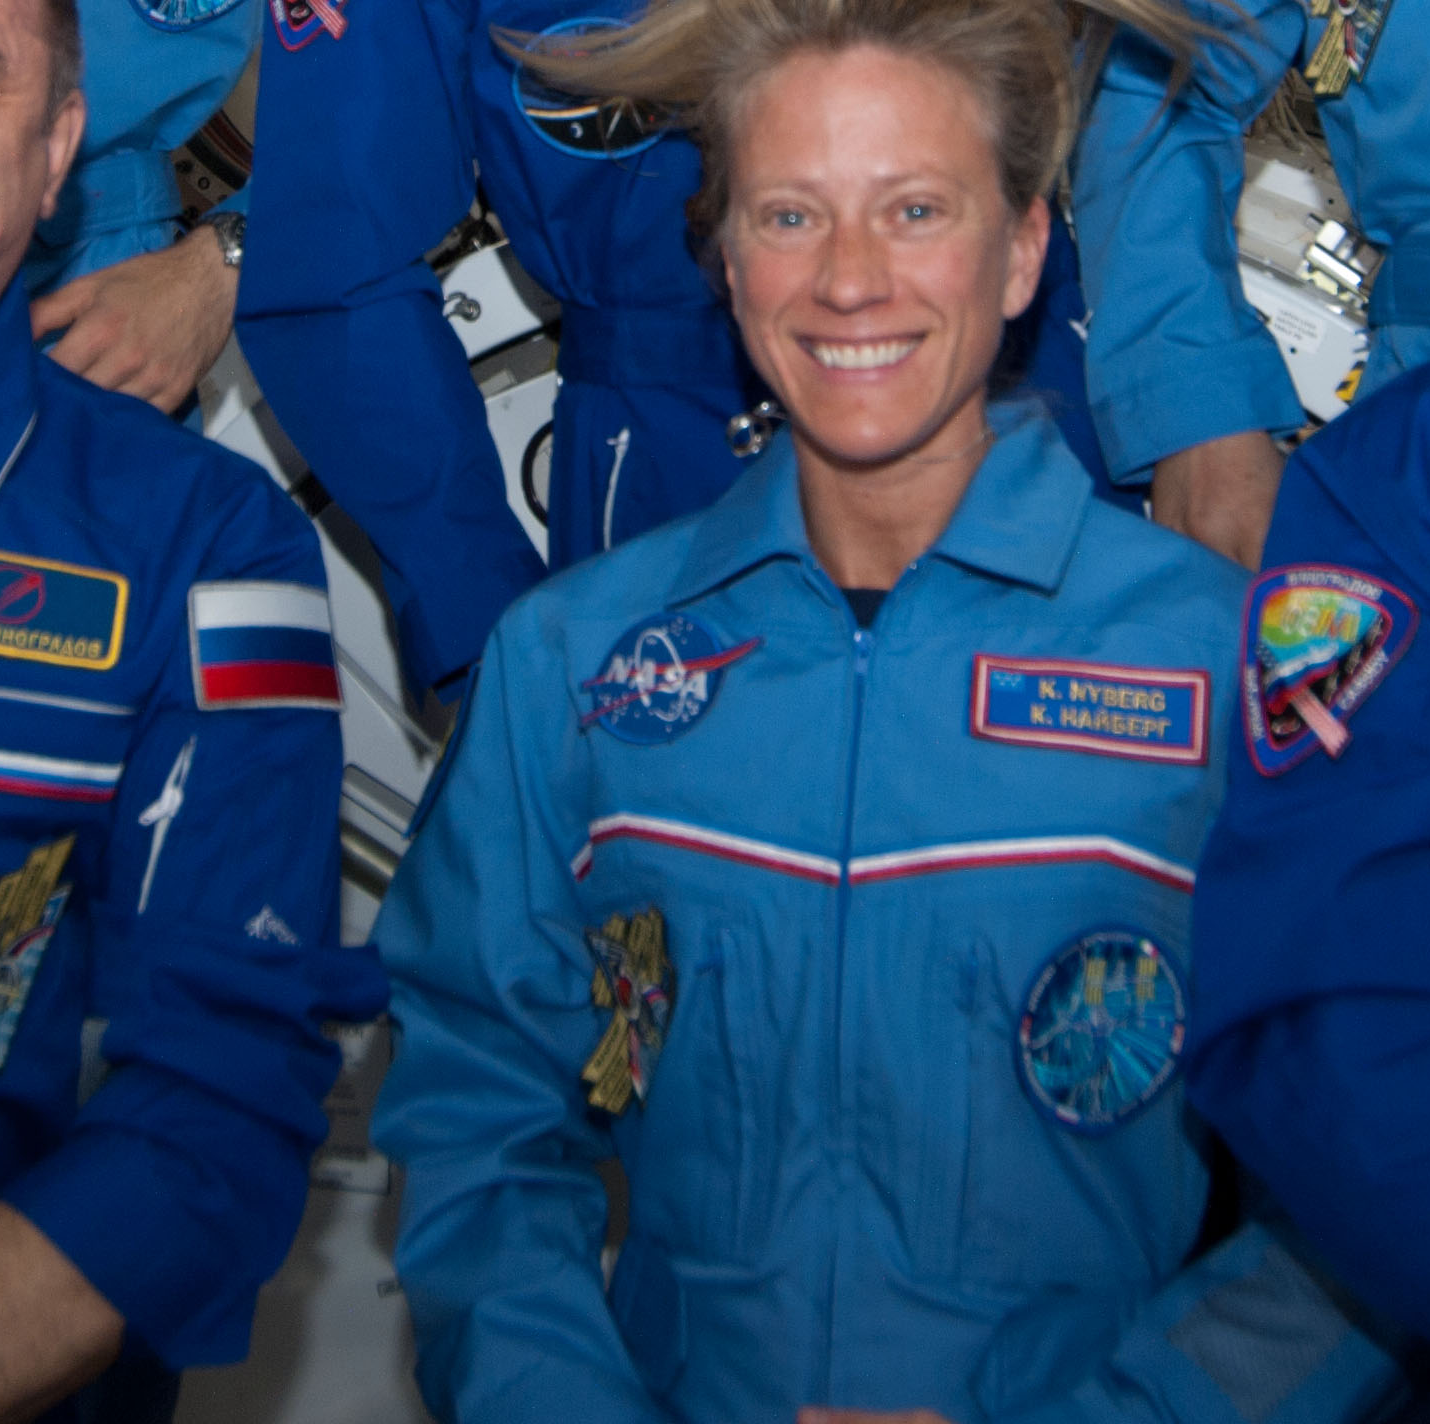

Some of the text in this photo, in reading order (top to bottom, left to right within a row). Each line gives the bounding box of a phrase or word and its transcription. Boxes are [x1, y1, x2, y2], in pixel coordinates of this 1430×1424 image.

[605, 654, 708, 707] NASA
[1069, 679, 1166, 712] NYBERG
[1060, 705, 1172, 738] НАЙБЕРГ
